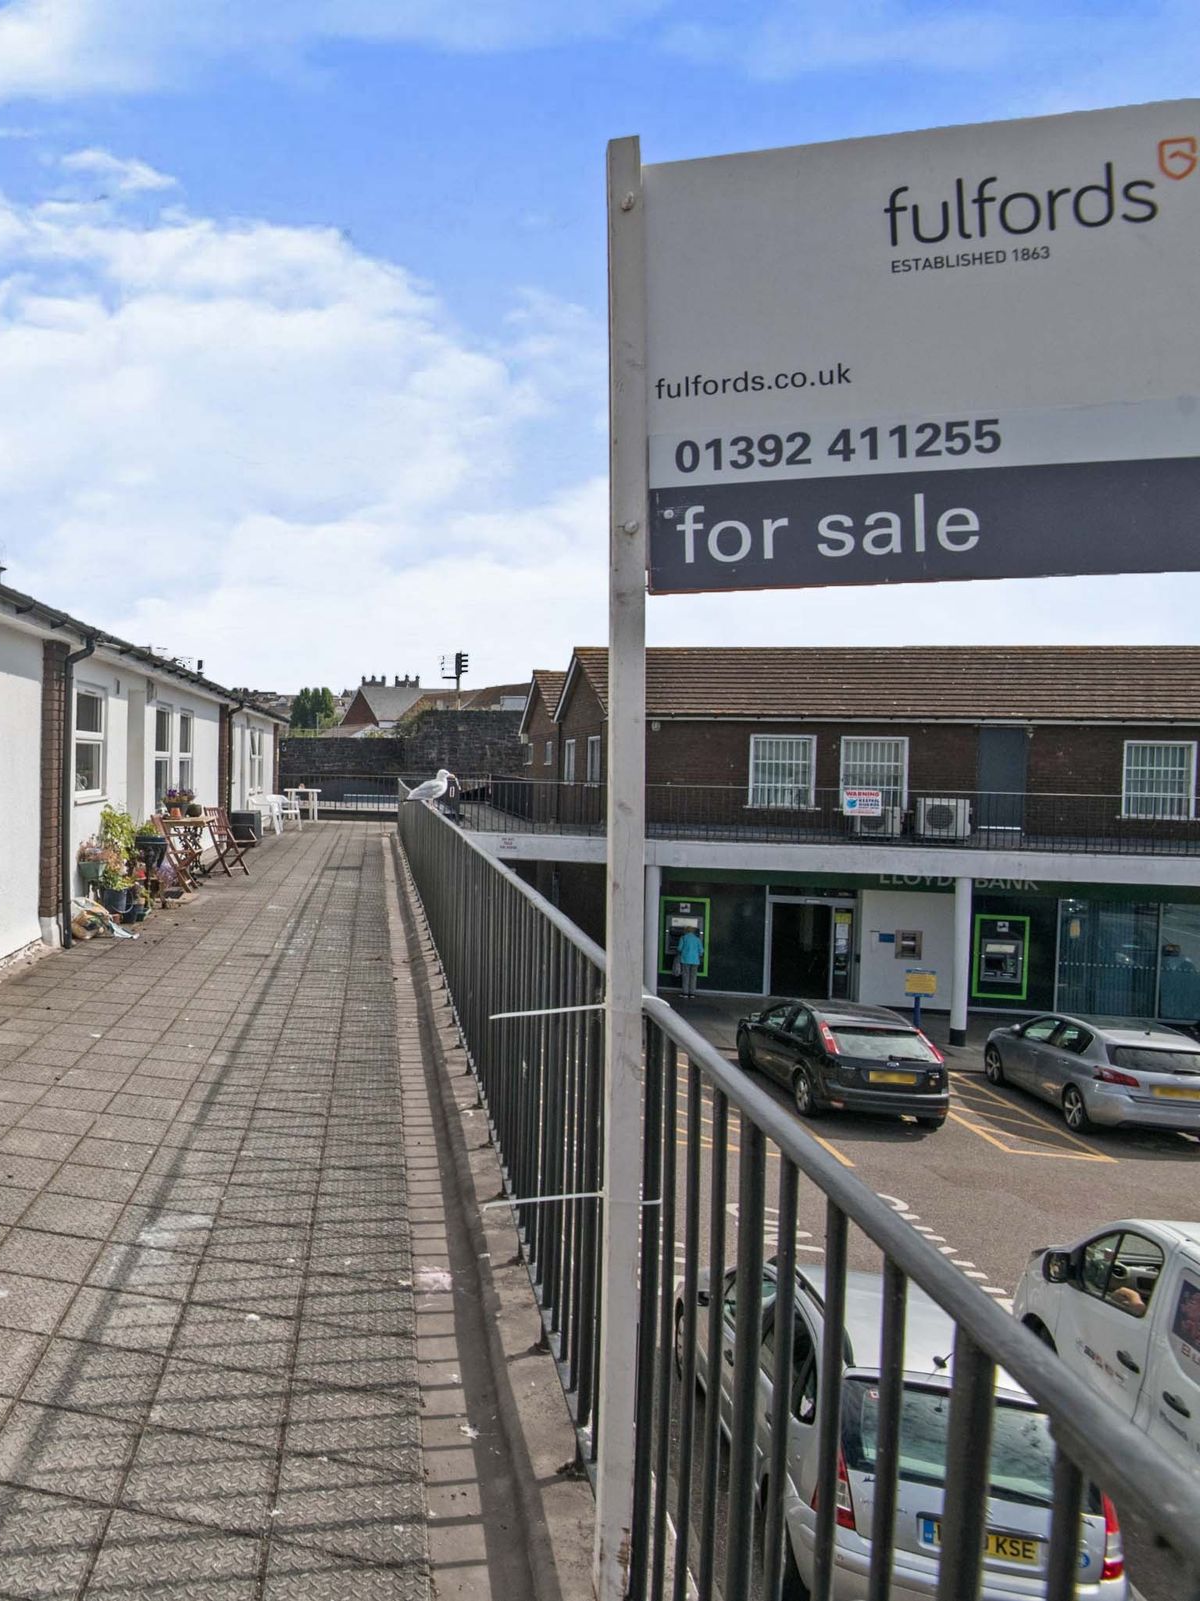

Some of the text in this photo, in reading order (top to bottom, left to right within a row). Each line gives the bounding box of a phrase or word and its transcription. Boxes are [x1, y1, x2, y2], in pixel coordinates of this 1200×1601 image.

[884, 161, 1159, 247] fulfords
[891, 246, 1051, 274] ESTABLISHED 1863
[655, 362, 852, 400] fulfords.co.uk
[674, 418, 1002, 474] 01392 411255
[676, 493, 981, 564] for sale
[879, 873, 1039, 891] LLOYD BANK
[995, 1535, 1035, 1560] KSE
